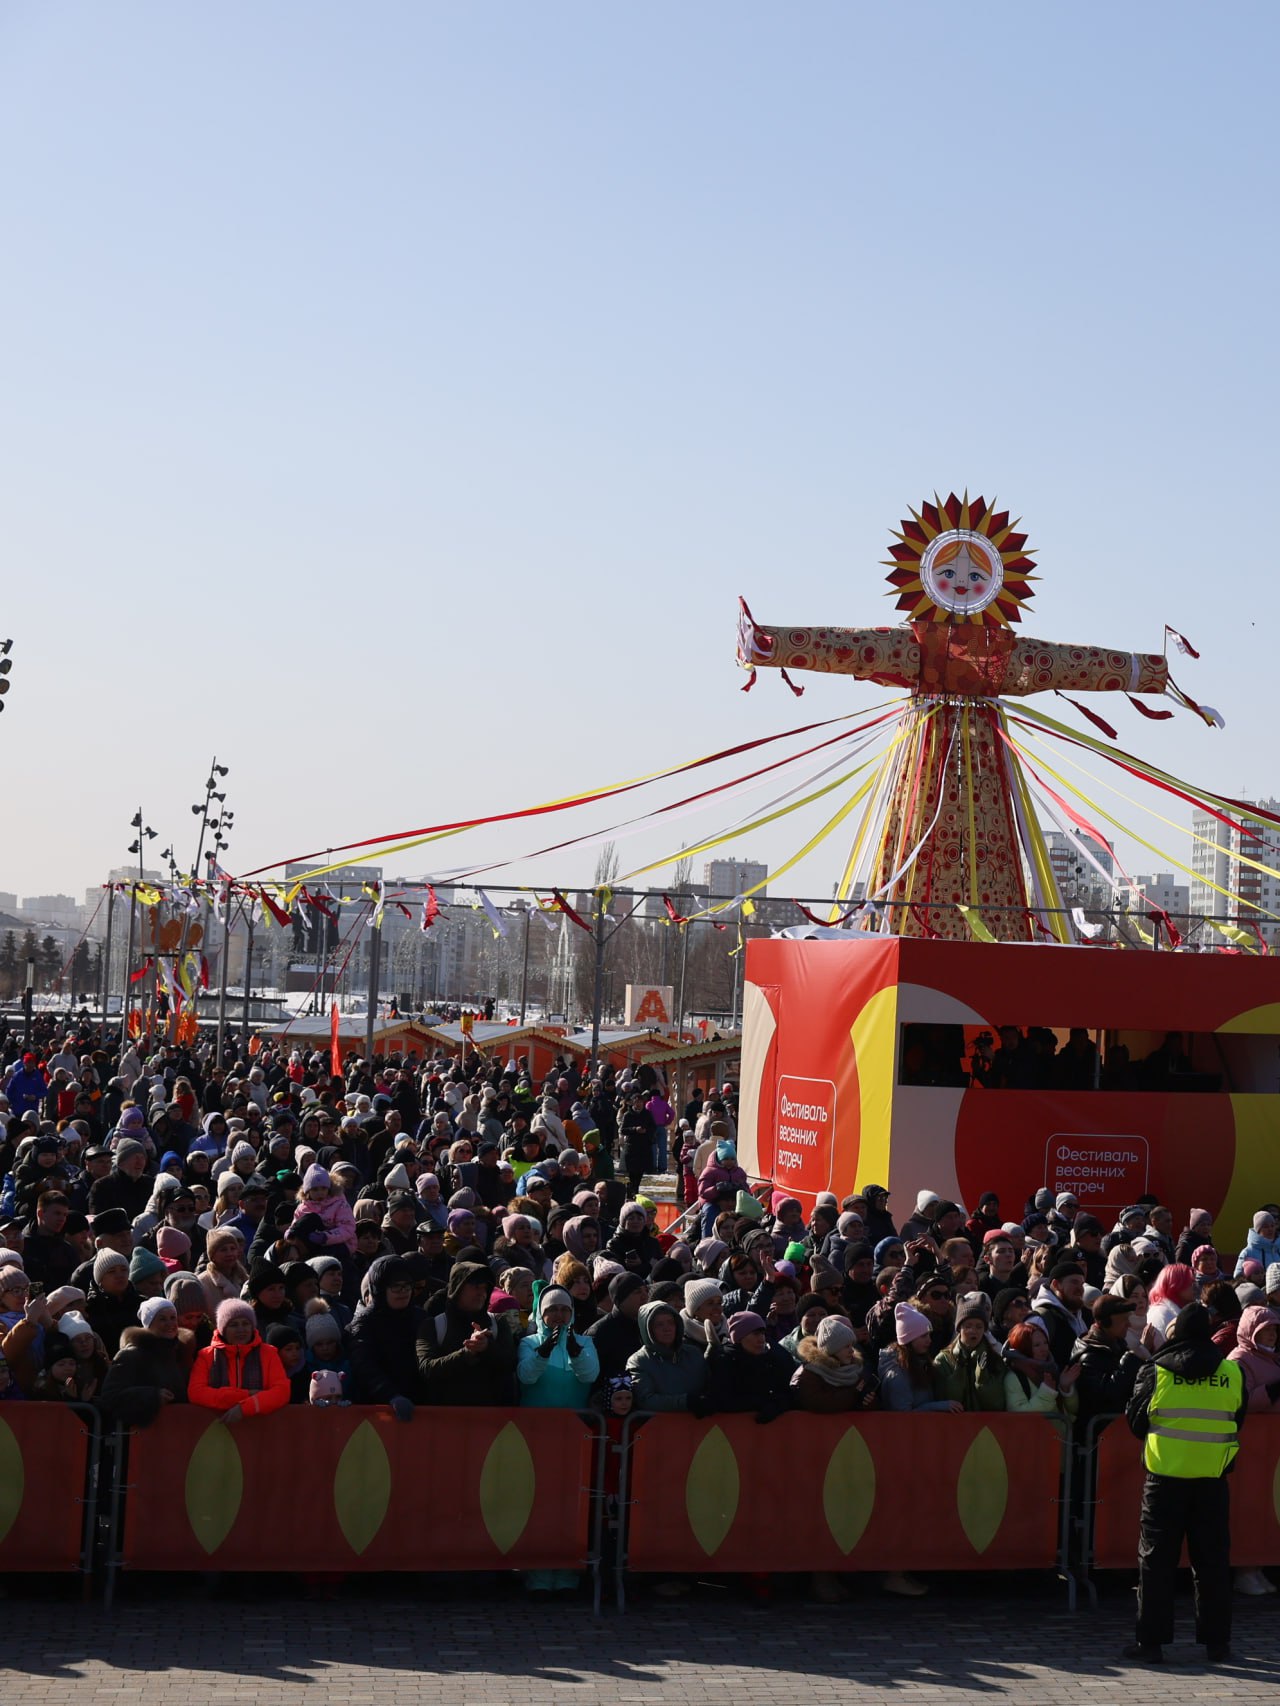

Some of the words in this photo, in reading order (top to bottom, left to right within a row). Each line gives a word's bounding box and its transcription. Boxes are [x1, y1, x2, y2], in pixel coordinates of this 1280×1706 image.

[780, 1092, 828, 1122] Фестиваль
[779, 1125, 818, 1147] весенних
[778, 1149, 803, 1173] встреч
[1056, 1145, 1139, 1163] Фестиваль
[1055, 1166, 1126, 1178] весенних
[1055, 1182, 1105, 1197] встреч
[1173, 1373, 1230, 1388] БОРЕЙ
